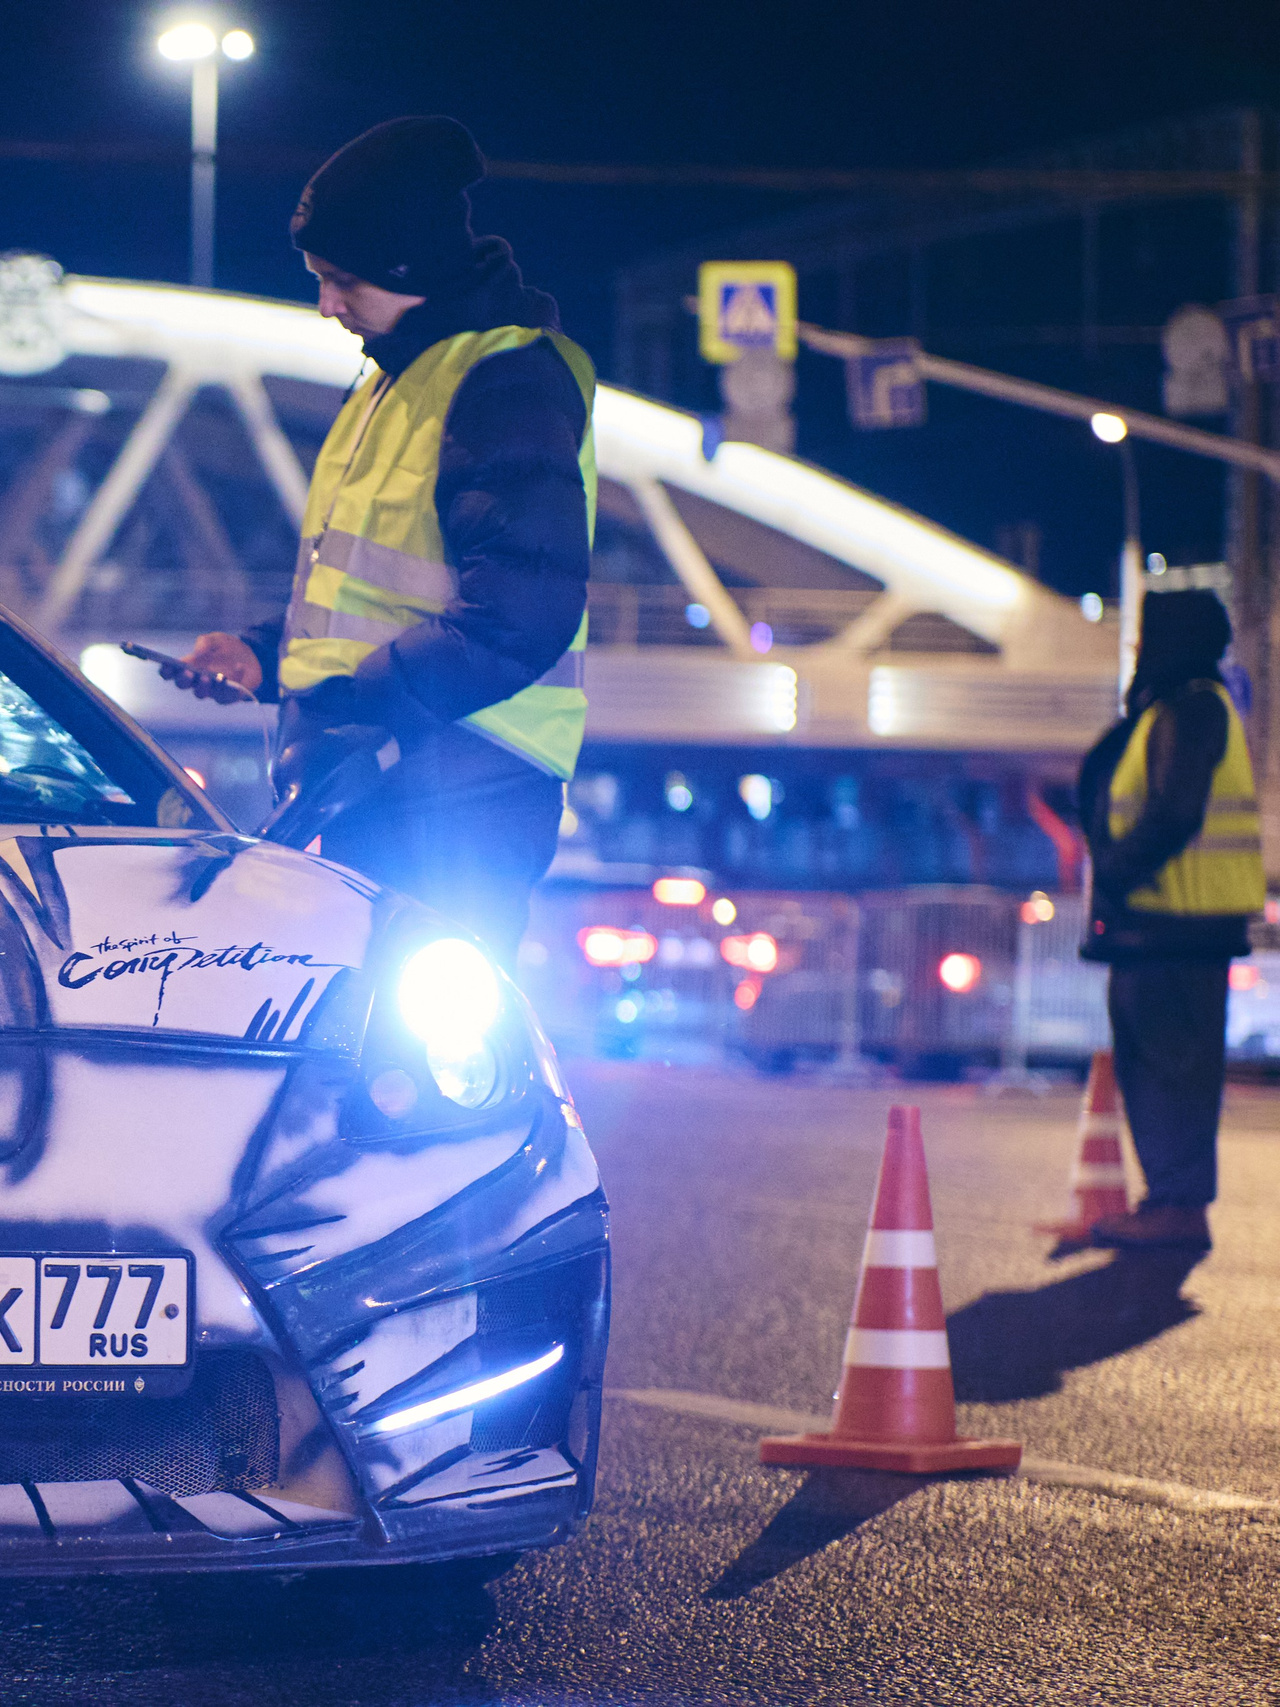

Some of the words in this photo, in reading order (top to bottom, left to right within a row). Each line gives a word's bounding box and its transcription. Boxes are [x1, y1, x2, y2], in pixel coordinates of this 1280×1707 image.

[163, 931, 198, 945] of
[44, 1264, 166, 1330] 777
[89, 1333, 149, 1358] RUS
[62, 1379, 126, 1393] РОССИИ
